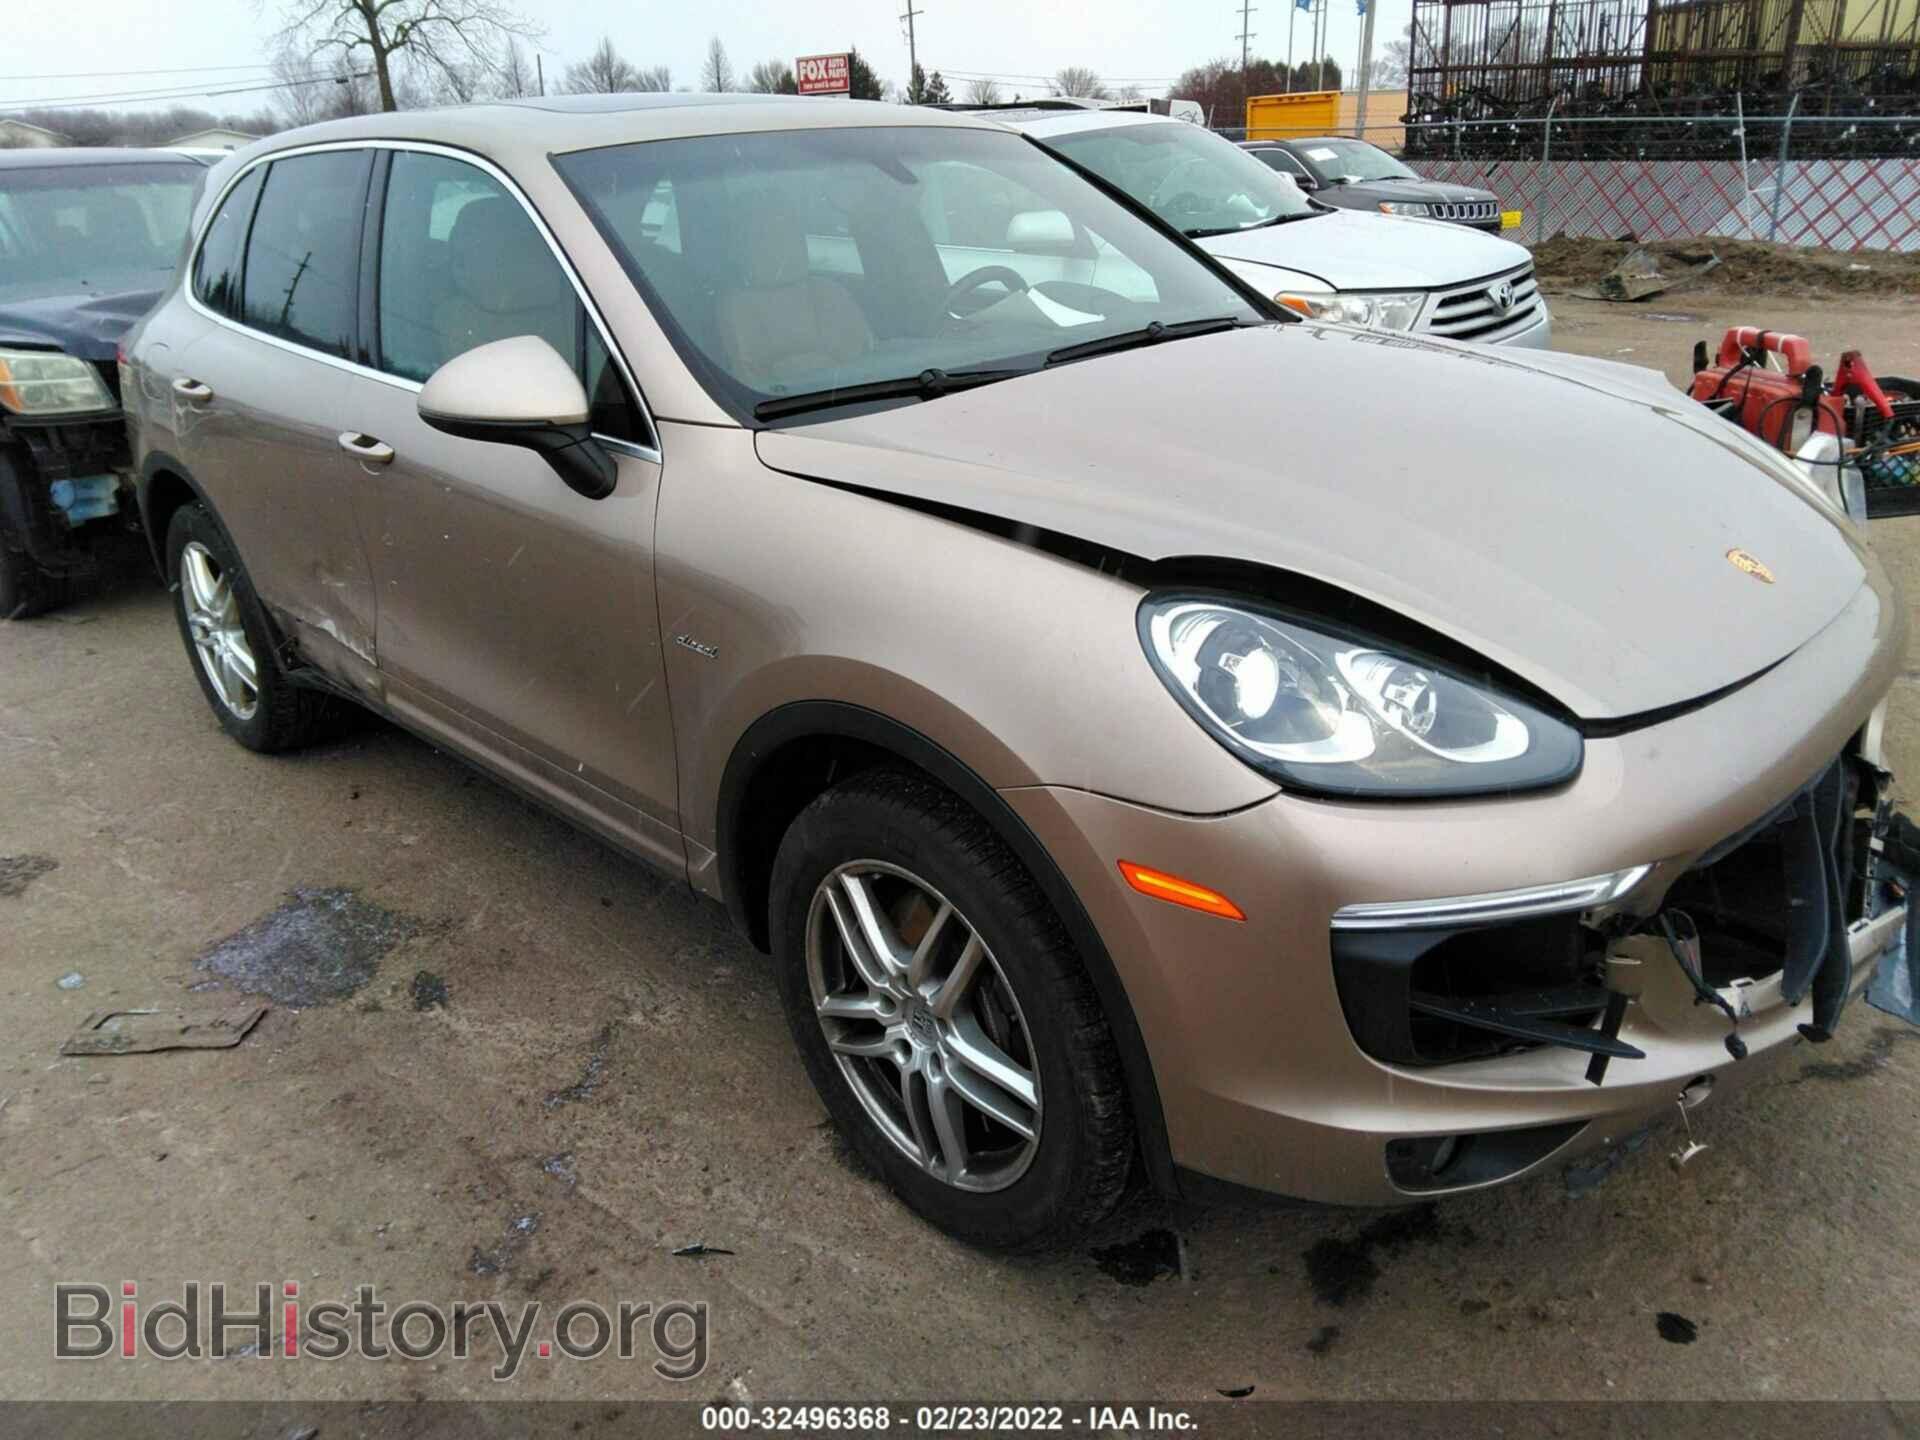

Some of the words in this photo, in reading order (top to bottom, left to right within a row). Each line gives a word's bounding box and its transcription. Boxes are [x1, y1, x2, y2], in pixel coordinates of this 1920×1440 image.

[828, 57, 845, 68] AUTO
[800, 58, 828, 81] FOX
[828, 68, 847, 79] PARTS
